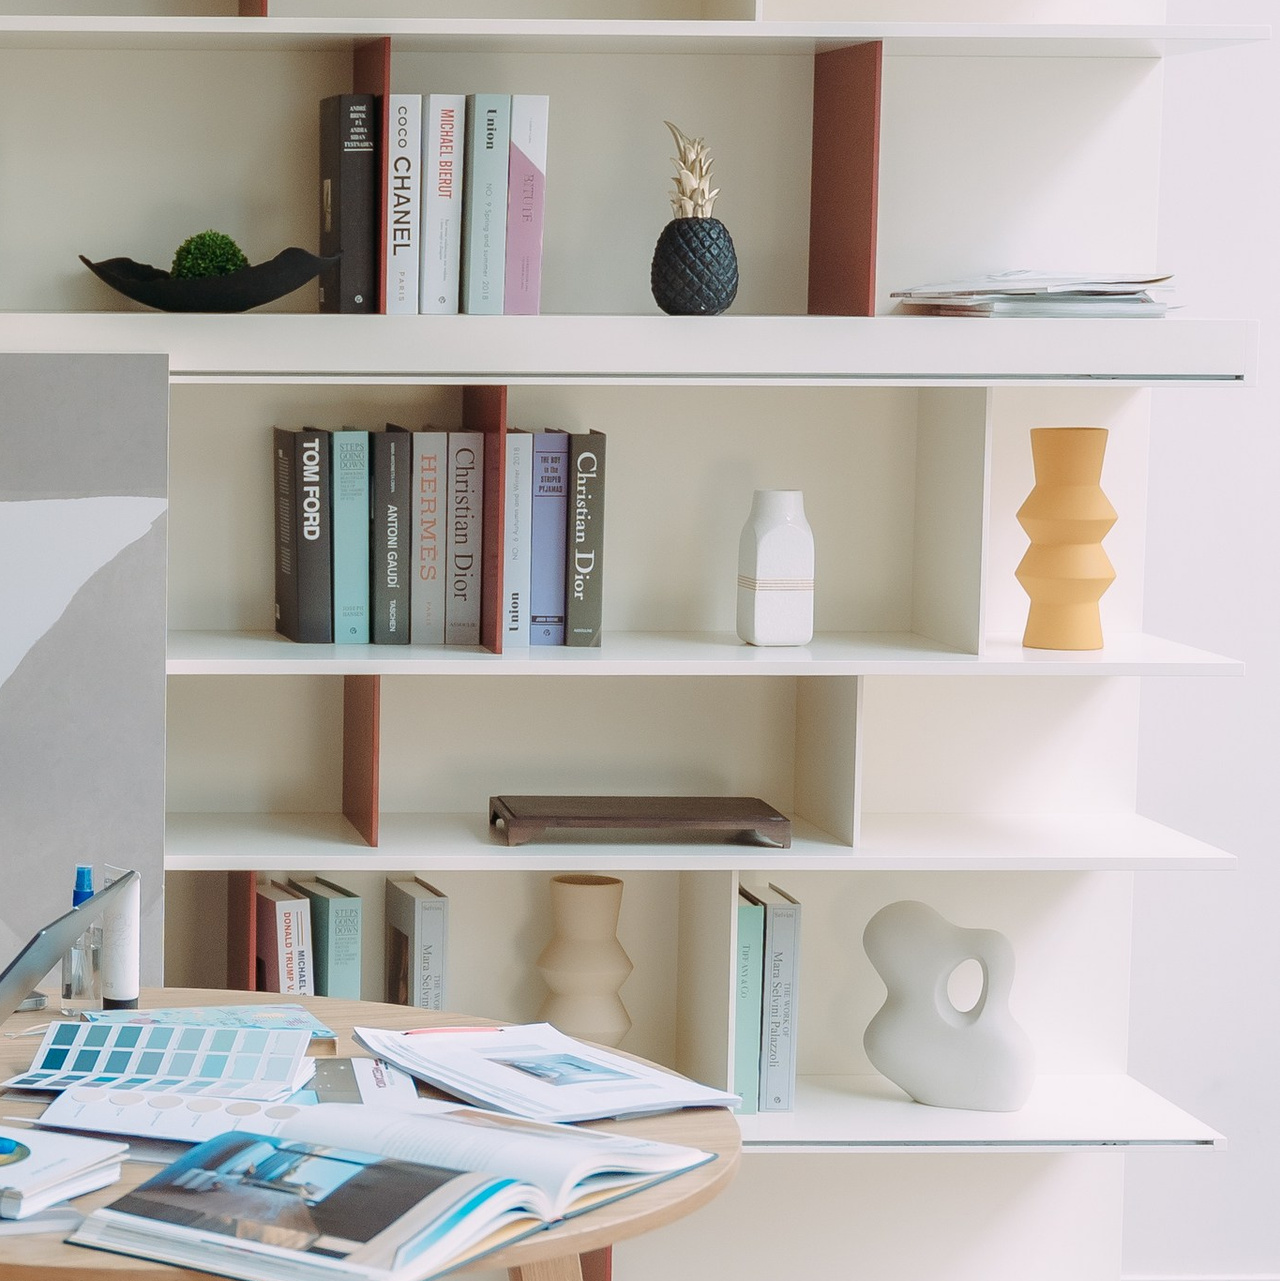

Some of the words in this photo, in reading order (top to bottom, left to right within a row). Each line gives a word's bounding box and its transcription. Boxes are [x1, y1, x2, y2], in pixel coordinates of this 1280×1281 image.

[397, 106, 407, 148] COCO
[439, 109, 454, 157] MICHAEL
[486, 109, 497, 150] Union
[438, 160, 453, 199] BIERUT
[393, 156, 411, 256] CHANEL
[482, 209, 491, 232] Spring
[483, 234, 491, 248] and
[303, 438, 319, 482] TOM
[455, 447, 475, 545] Christian
[538, 485, 563, 493] PYJAMAS
[575, 451, 597, 543] Christian
[303, 486, 320, 541] FORD
[387, 504, 398, 549] ANTONI
[387, 552, 400, 588] GAUDÍ
[453, 554, 474, 601] Dior
[574, 549, 595, 600] Dior
[509, 592, 519, 632] Union
[283, 912, 293, 949] DONALD
[334, 909, 359, 917] STEPS
[334, 927, 358, 935] DOWN
[285, 951, 295, 982] TRUMP
[297, 950, 307, 991] MICHAEL
[422, 944, 433, 971] Mara
[772, 951, 783, 979] Mara
[433, 989, 442, 1010] WOR
[772, 982, 782, 1017] Selvini
[783, 998, 791, 1024] WORK
[769, 1020, 781, 1068] Palazzoli
[782, 1026, 790, 1038] OF
